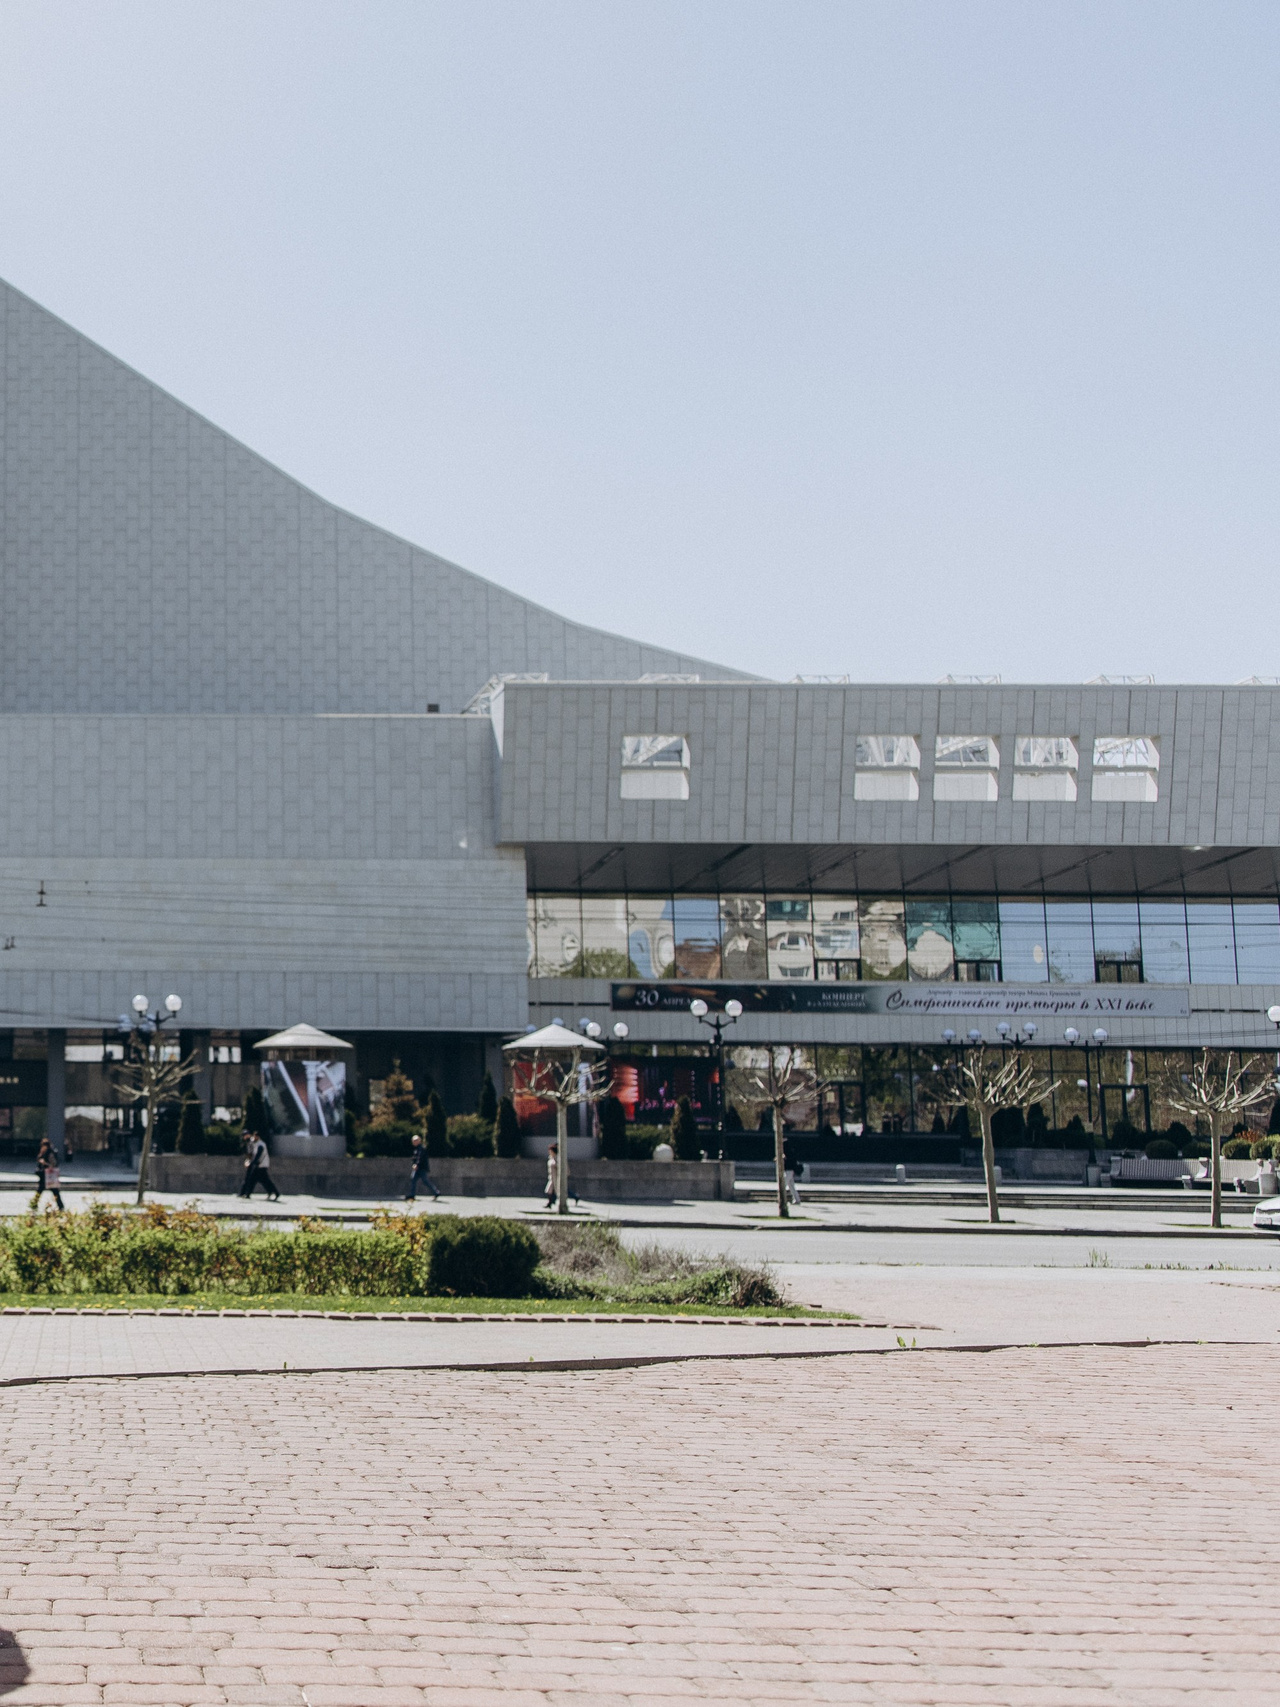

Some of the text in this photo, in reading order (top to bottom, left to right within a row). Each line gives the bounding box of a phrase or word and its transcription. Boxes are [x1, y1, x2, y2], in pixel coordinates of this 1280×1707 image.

[635, 989, 691, 1006] 30 АПРЕЛ
[886, 989, 1001, 1012] Симфонические
[1005, 999, 1075, 1013] премьеры
[1095, 998, 1122, 1010] XXI
[1125, 998, 1156, 1011] веке
